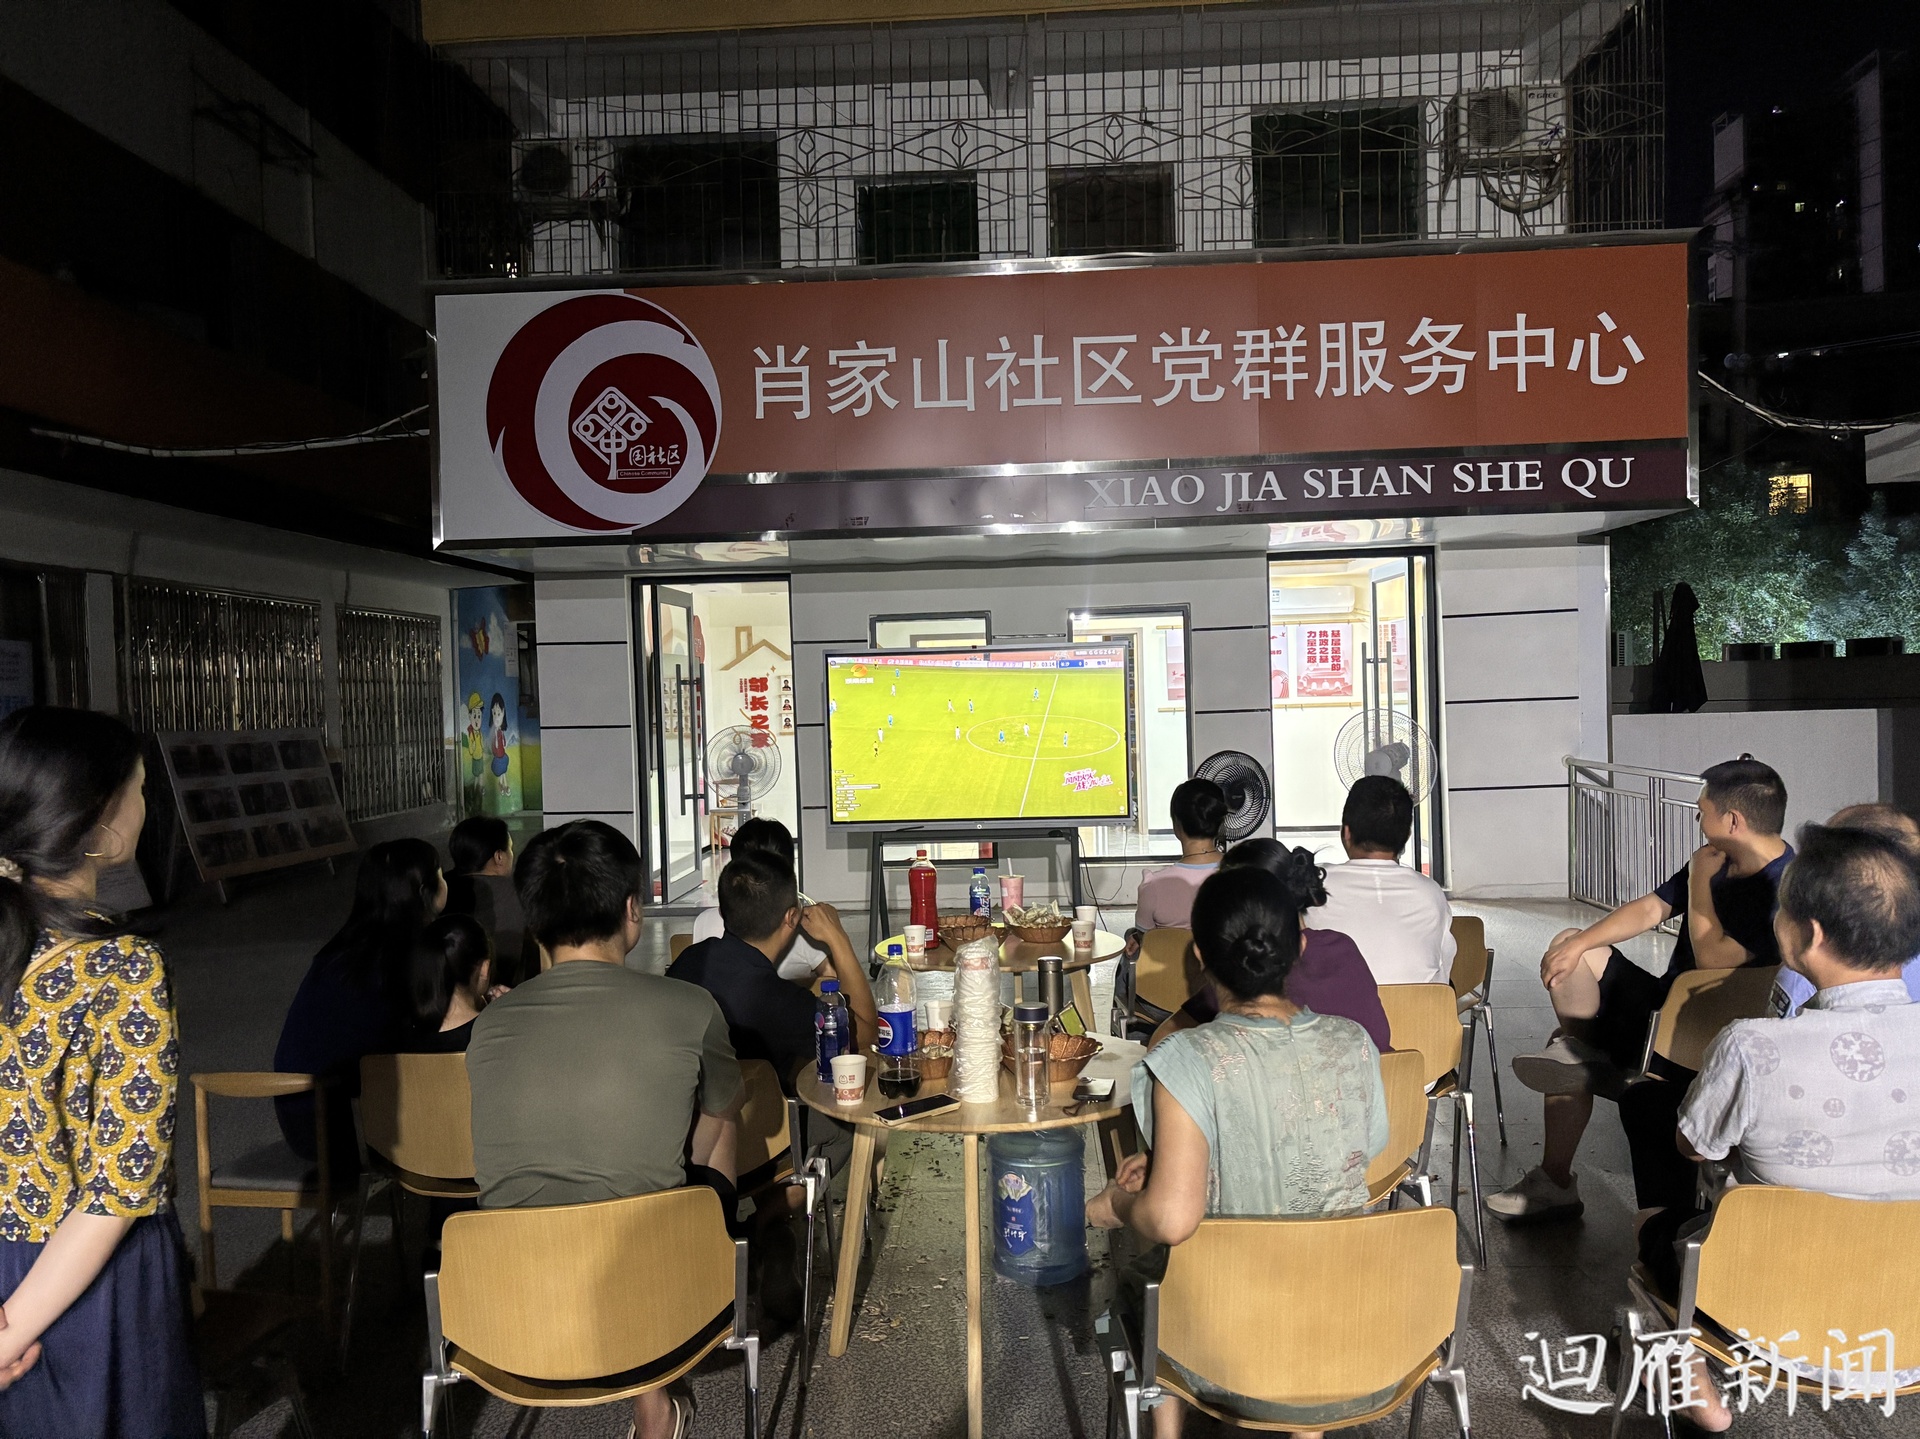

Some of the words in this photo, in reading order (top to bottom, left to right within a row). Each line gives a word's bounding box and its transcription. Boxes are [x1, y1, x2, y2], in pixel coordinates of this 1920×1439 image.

[753, 311, 1645, 420] 肖家山社区党群服务中心
[1085, 473, 1205, 509] XIAO
[1216, 470, 1287, 512] JIA
[1303, 464, 1435, 500] SHAN
[1453, 460, 1543, 494] SHE
[1561, 457, 1635, 499] QU
[1307, 630, 1317, 664] 力量之源
[1319, 630, 1329, 664] 执政之基
[1331, 629, 1341, 672] 基层是党的
